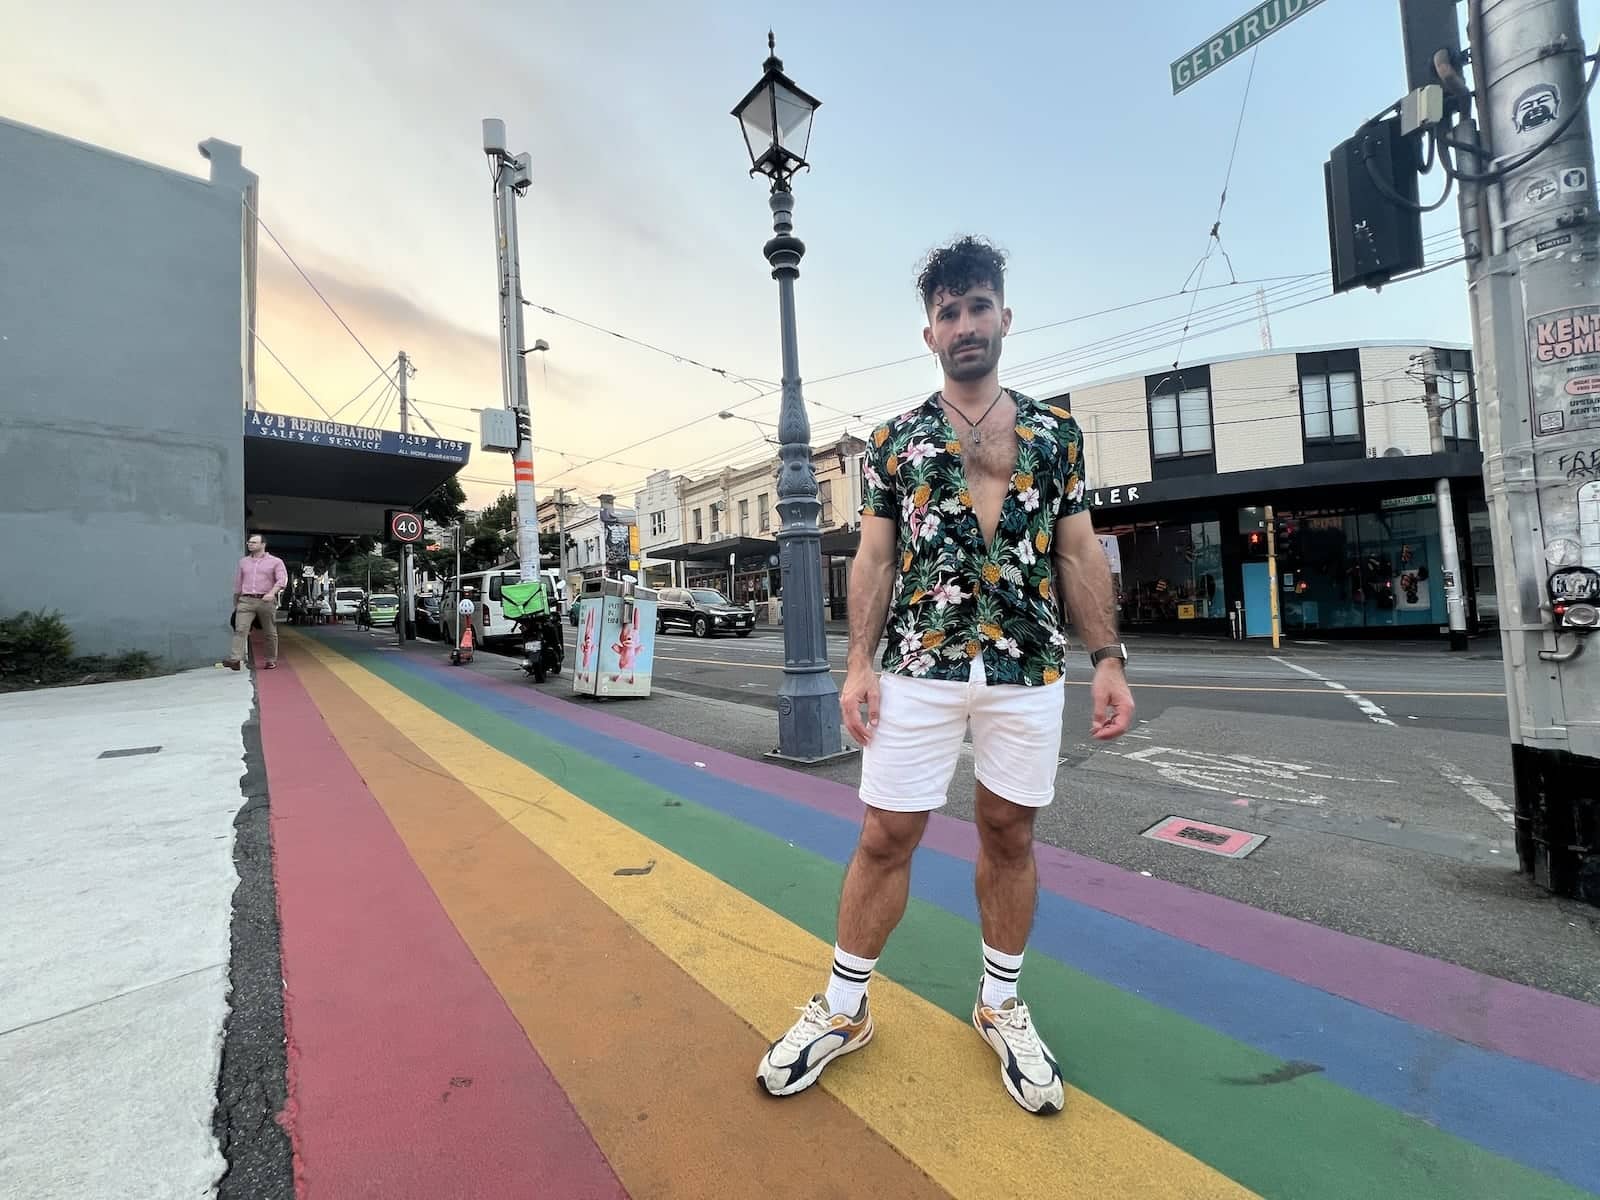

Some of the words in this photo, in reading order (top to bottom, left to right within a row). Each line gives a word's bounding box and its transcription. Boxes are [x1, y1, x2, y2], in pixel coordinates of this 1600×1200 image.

[1176, 0, 1321, 86] GERTRUD
[1537, 314, 1600, 345] KENT
[252, 412, 260, 425] A
[264, 415, 274, 426] &
[277, 415, 286, 428] B
[289, 417, 383, 442] REFRIGERATION
[260, 426, 304, 441] SALES
[328, 436, 382, 450] SERVICE
[1088, 486, 1140, 506] LER
[397, 520, 417, 534] 40
